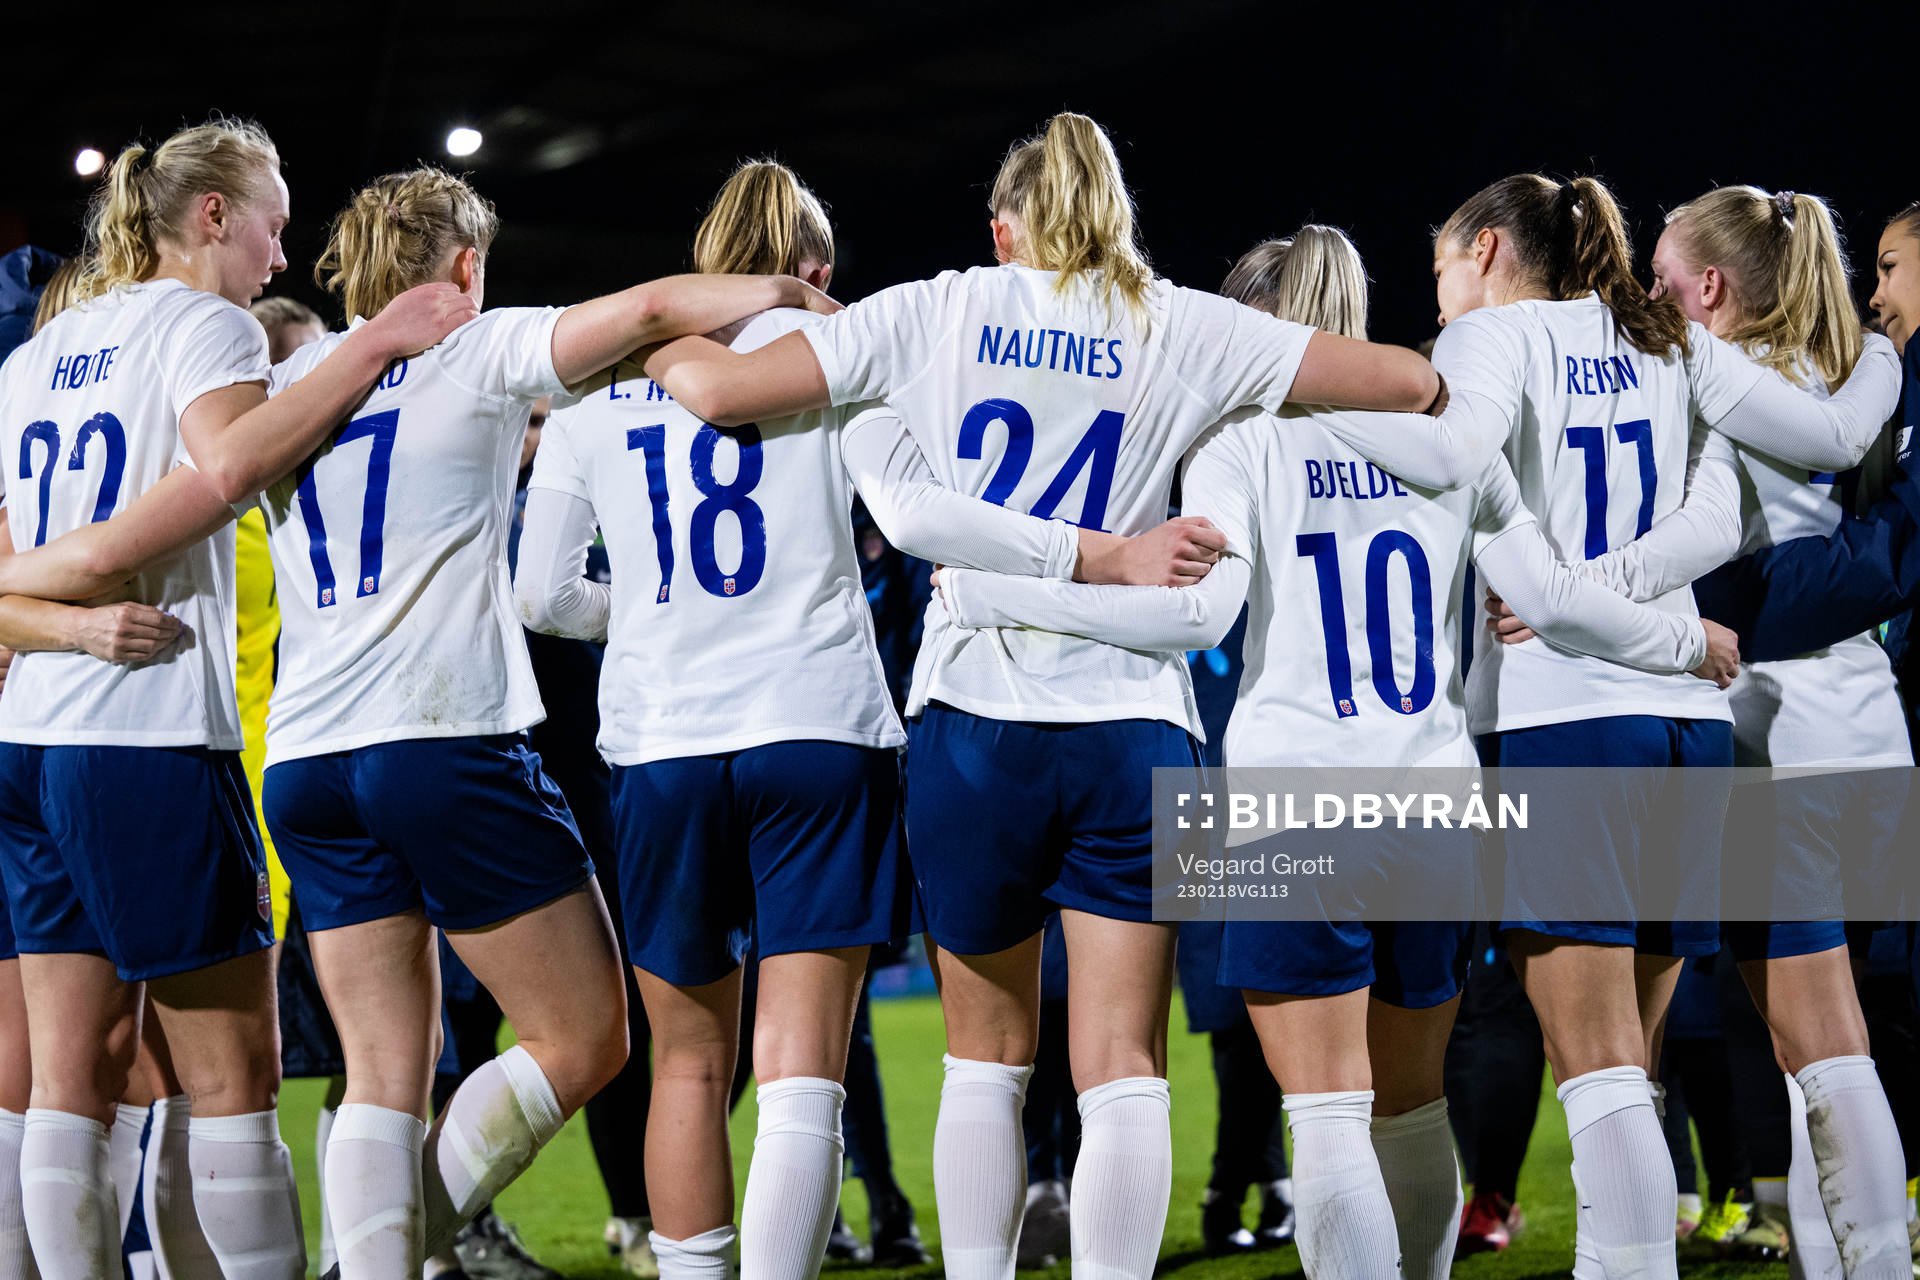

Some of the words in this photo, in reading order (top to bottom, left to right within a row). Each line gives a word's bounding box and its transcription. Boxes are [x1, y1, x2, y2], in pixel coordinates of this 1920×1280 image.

[977, 324, 1123, 380] NAUTNES
[18, 411, 128, 547] 22
[296, 407, 401, 609] 17
[626, 423, 767, 605] 18
[956, 397, 1126, 533] 24
[1565, 418, 1658, 561] 11
[1295, 529, 1437, 720] 10
